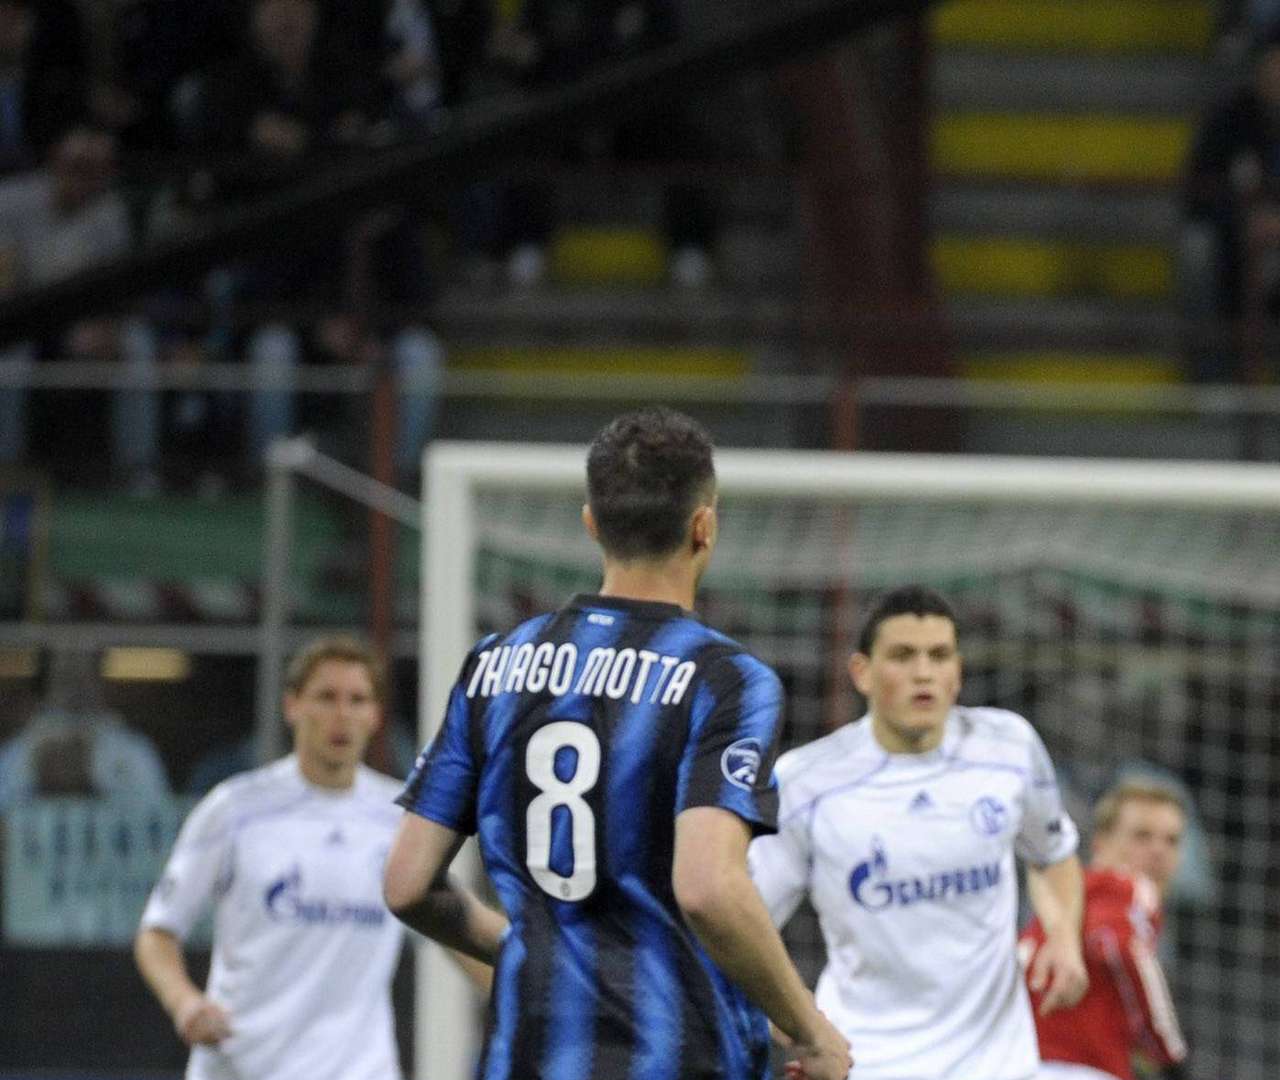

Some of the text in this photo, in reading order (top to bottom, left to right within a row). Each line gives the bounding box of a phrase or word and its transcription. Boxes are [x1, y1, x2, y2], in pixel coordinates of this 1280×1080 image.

[466, 642, 697, 706] THIAGO MOTTA
[525, 720, 601, 902] 8
